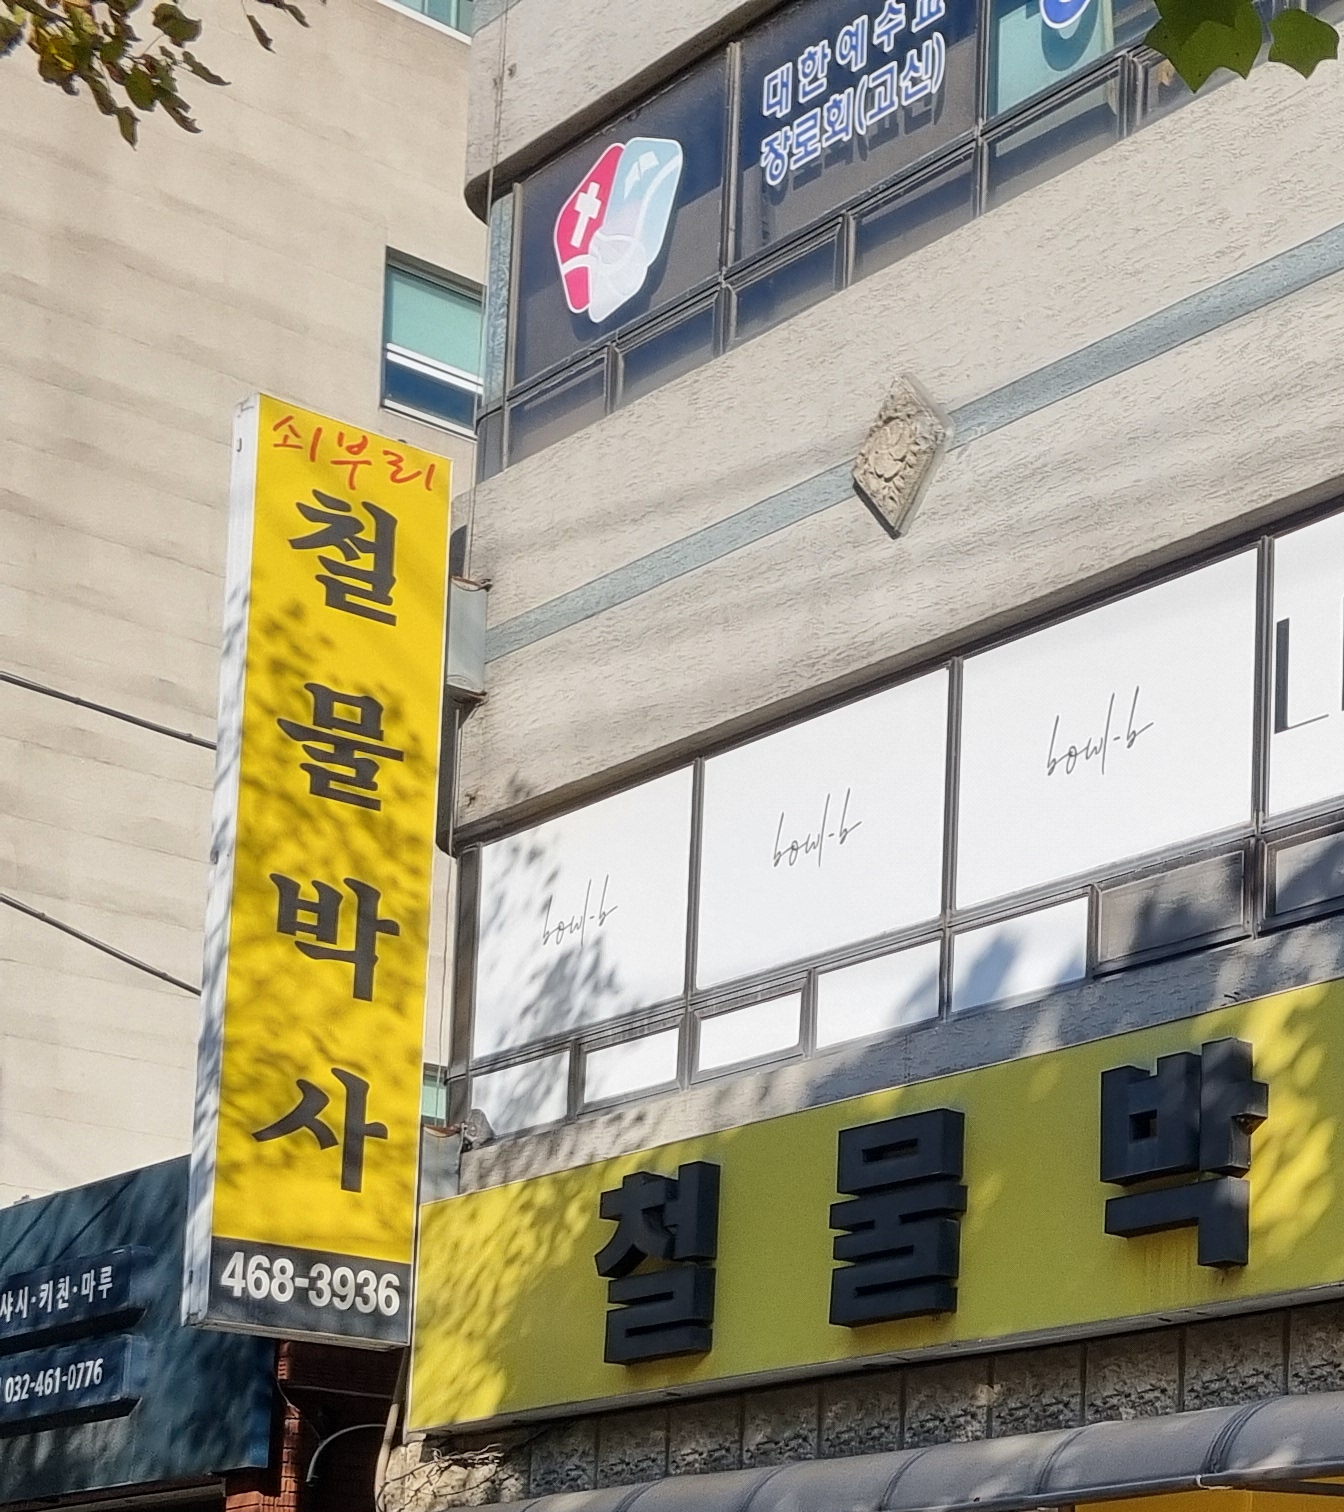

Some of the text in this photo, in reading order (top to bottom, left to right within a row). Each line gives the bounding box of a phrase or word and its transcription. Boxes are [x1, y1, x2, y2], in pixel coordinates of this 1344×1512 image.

[761, 32, 945, 185] 장로회(고신)
[273, 415, 436, 491] 쇠부리
[1046, 686, 1154, 776] bowl-b
[773, 788, 862, 868] bowl-b
[542, 875, 618, 946] bowl-b
[220, 1251, 401, 1317] 468-3936
[4, 1358, 104, 1404] 032-461-0776
